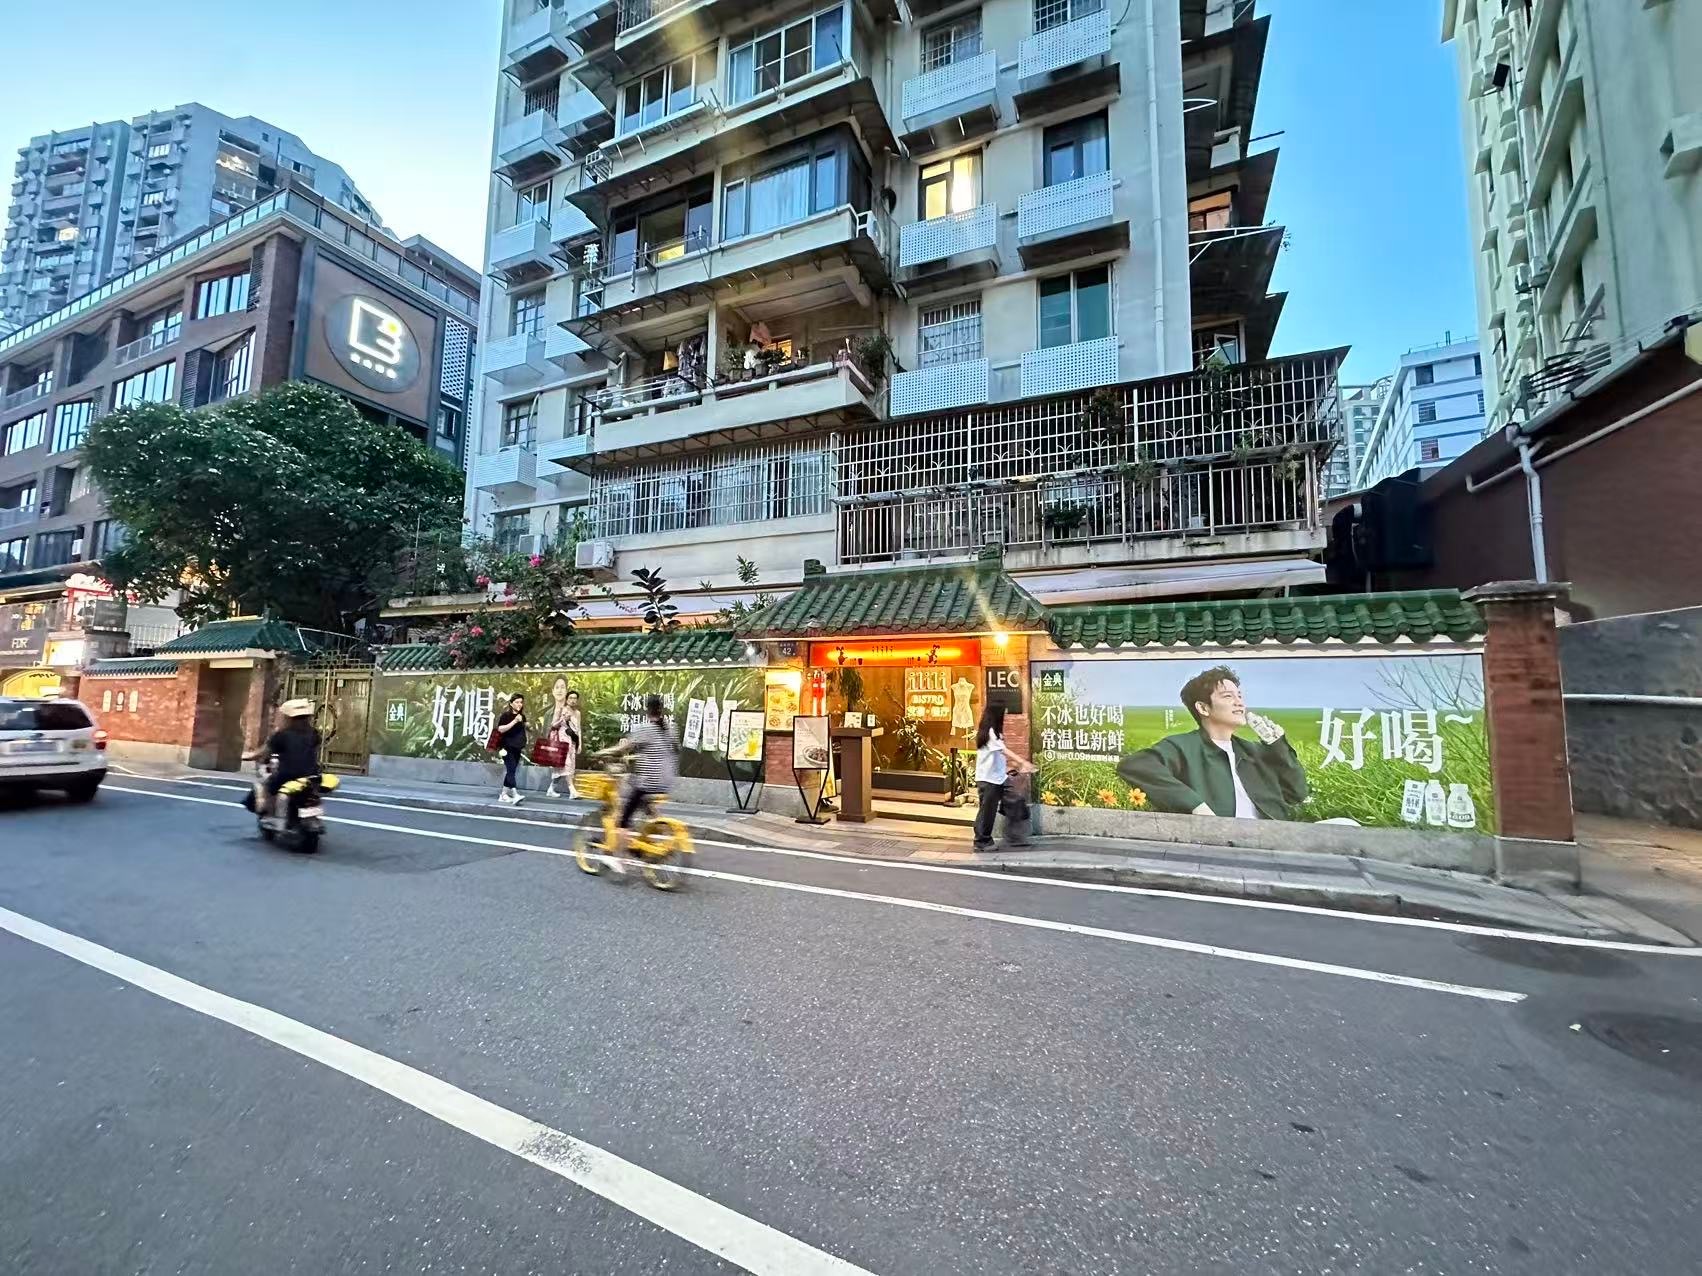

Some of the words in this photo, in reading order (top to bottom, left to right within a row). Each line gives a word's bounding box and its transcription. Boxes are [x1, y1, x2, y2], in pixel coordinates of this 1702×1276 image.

[1043, 673, 1063, 687] 金典
[620, 692, 675, 712] 不冰也喝
[1040, 704, 1124, 727] 不冰也好喝
[1041, 728, 1125, 752] 常温也新鲜
